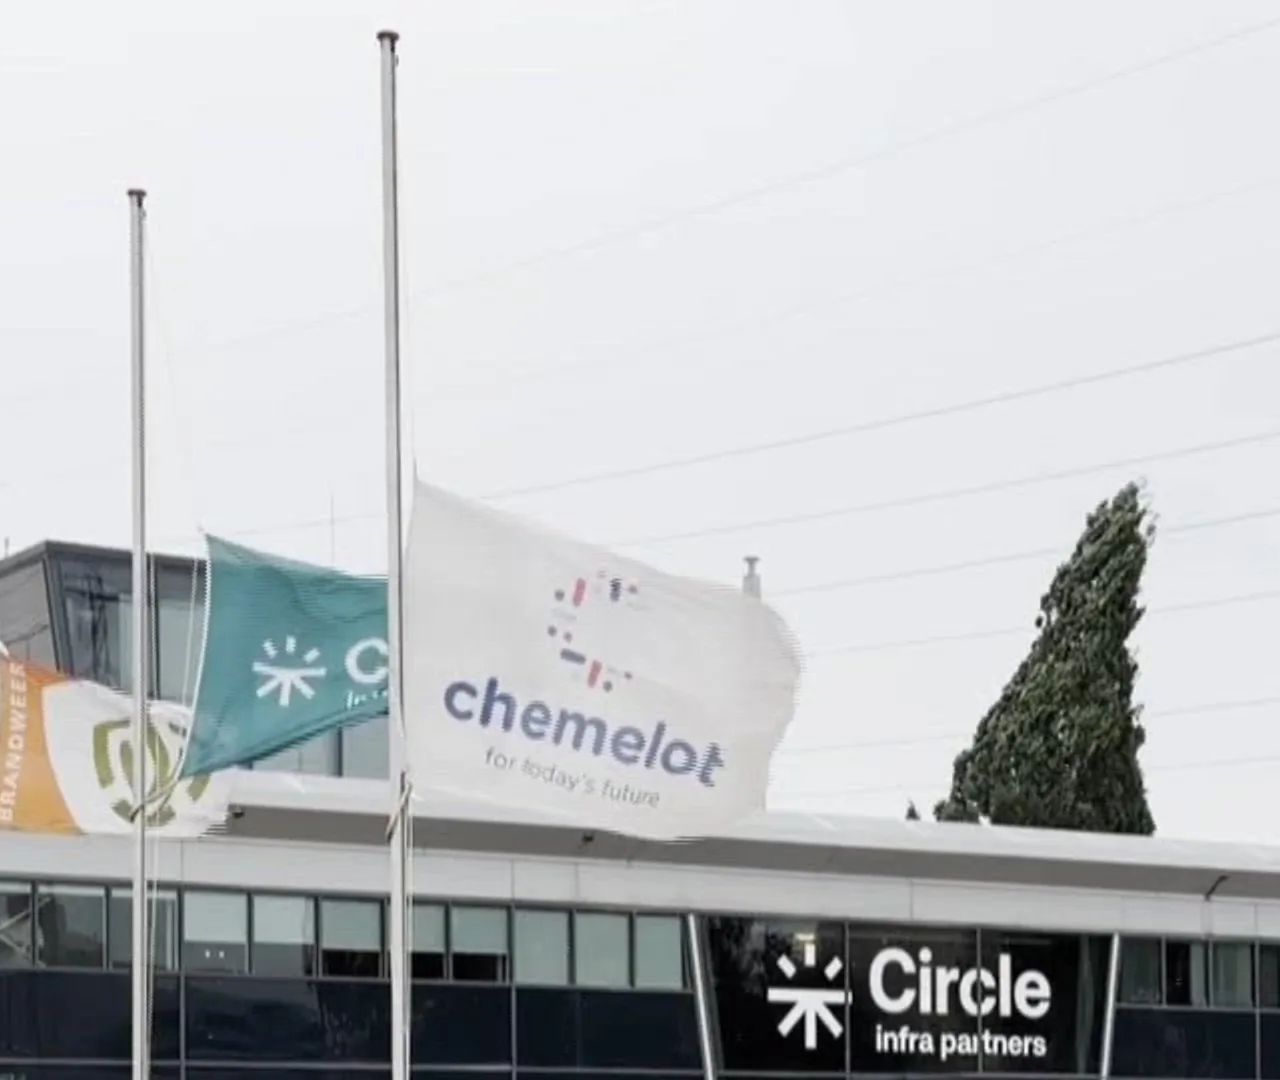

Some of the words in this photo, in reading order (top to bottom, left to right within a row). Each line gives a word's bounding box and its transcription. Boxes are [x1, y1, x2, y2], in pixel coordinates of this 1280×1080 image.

[443, 676, 726, 788] chemelot
[485, 746, 515, 771] for
[521, 758, 597, 796] today's
[602, 780, 661, 809] future
[869, 947, 1051, 1020] Circle
[875, 1024, 934, 1054] infra
[941, 1027, 1047, 1061] partners
